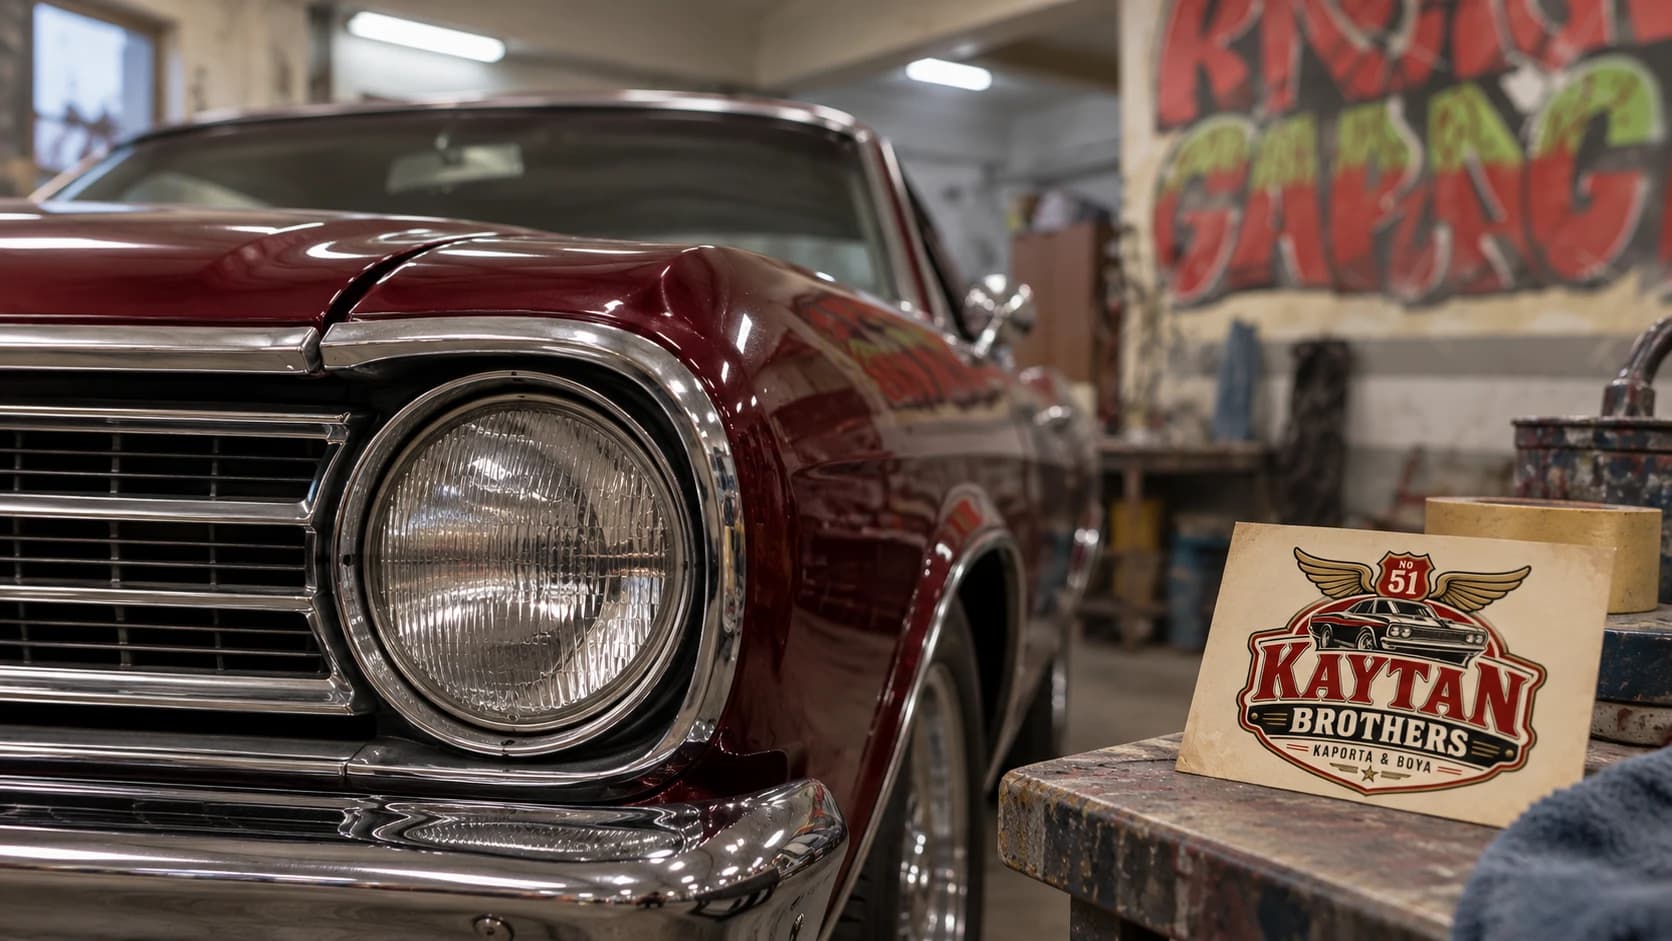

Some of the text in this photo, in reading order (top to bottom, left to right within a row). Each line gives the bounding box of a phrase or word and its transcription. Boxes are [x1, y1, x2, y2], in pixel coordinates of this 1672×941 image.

[1398, 560, 1414, 569] NO
[1387, 569, 1418, 595] 51
[1250, 641, 1529, 738] KAYTAN
[1289, 707, 1469, 758] BROTHERS
[1313, 744, 1432, 774] KAPORTA & BOYA
